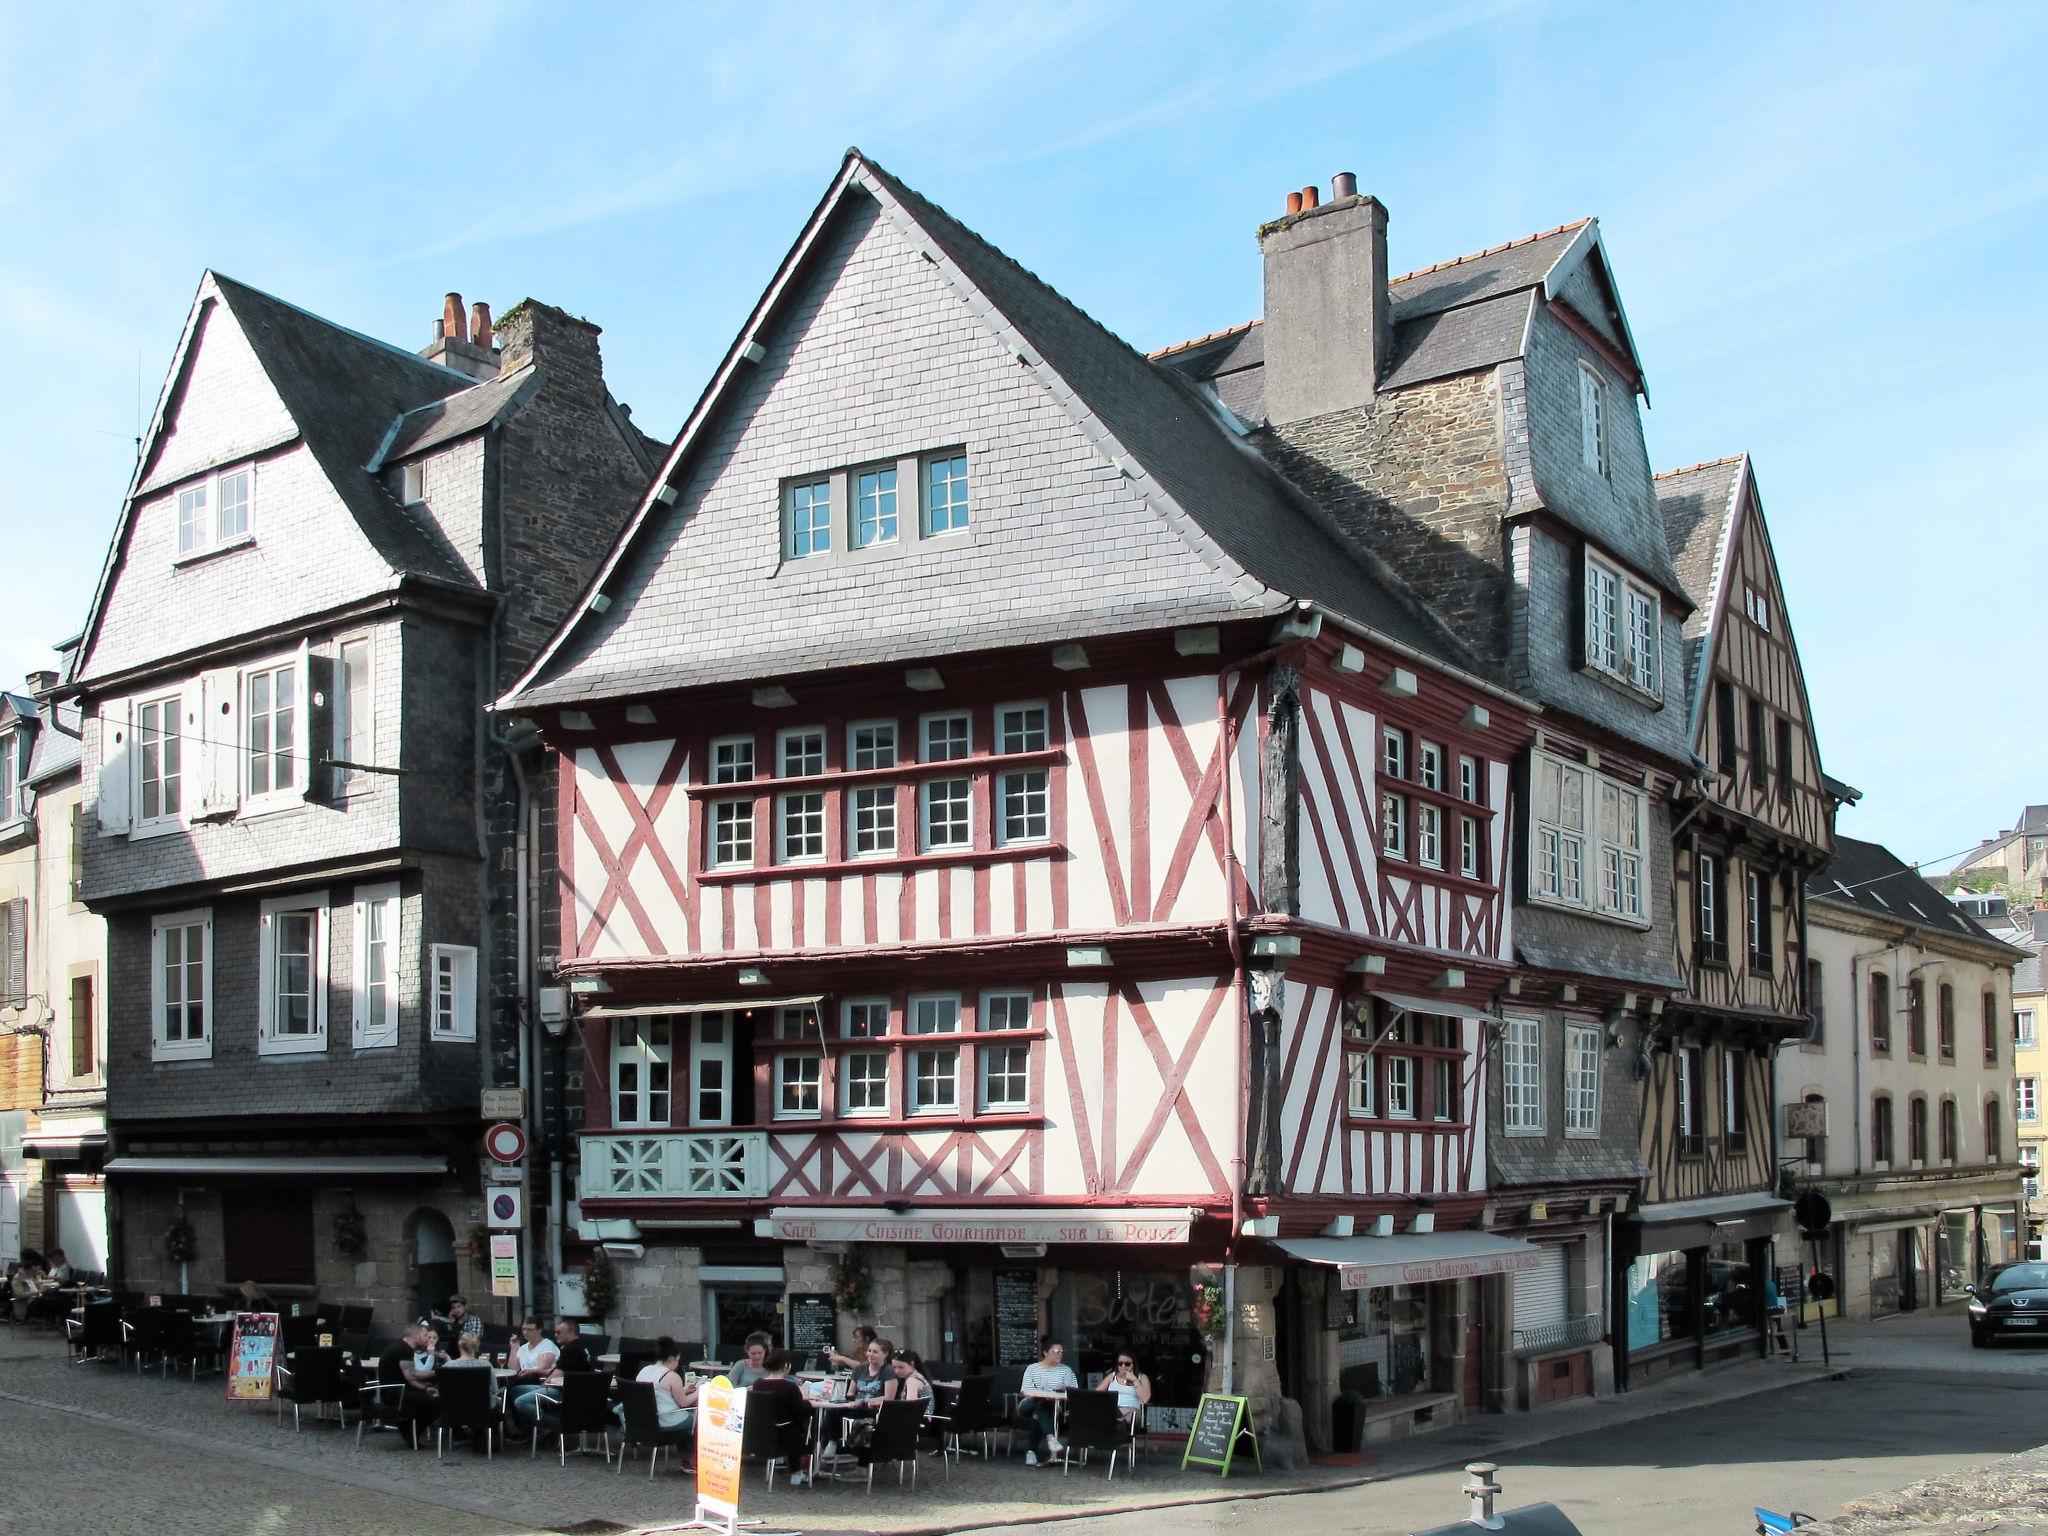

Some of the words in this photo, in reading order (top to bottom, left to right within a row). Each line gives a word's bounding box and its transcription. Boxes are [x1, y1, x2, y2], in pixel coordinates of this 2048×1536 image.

[866, 1222, 923, 1240] CUISINE
[932, 1223, 1027, 1241] GOURMANDE
[1060, 1228, 1087, 1242] SUR
[1097, 1228, 1114, 1242] LE
